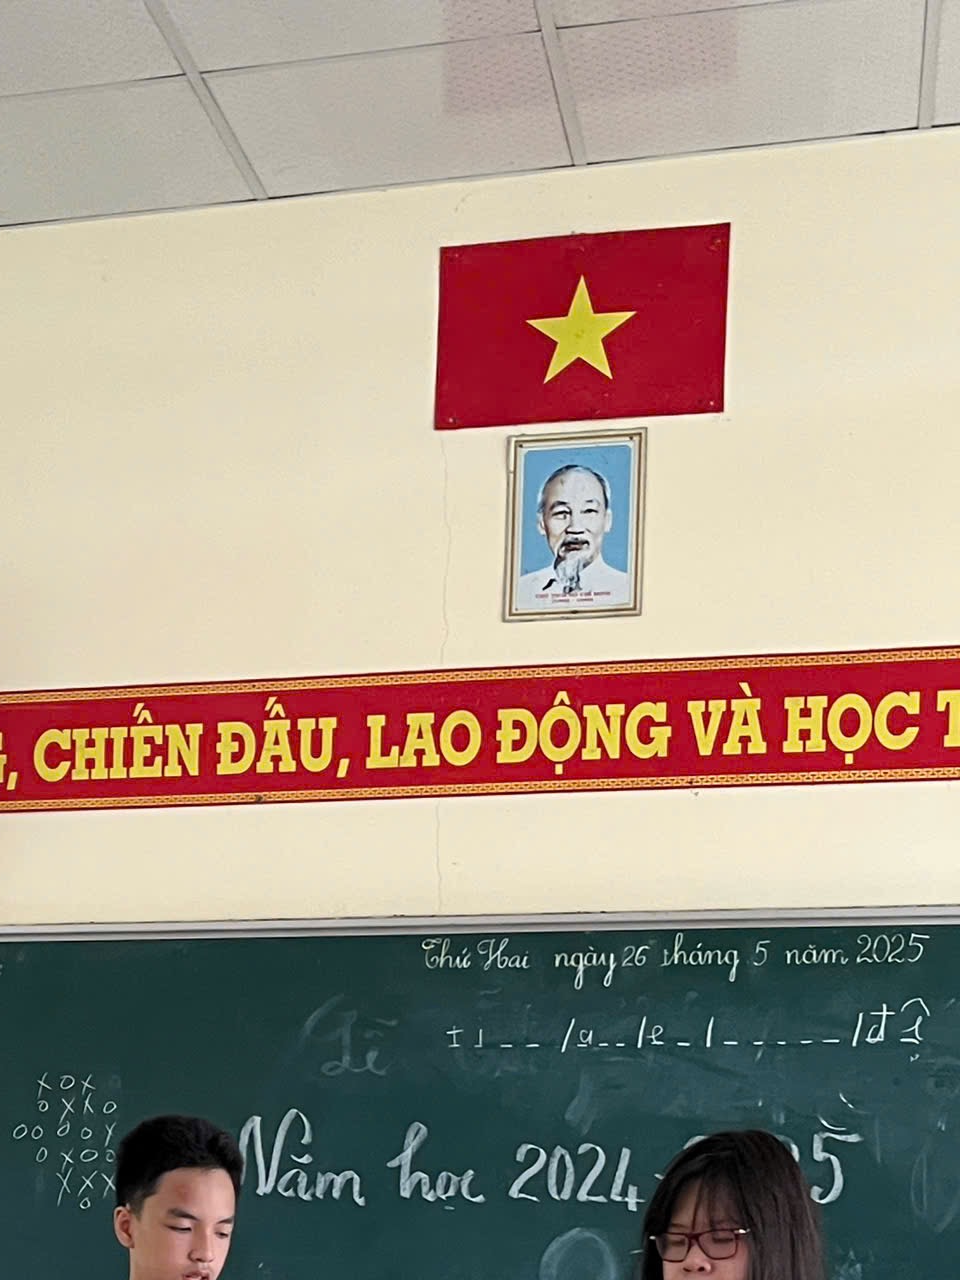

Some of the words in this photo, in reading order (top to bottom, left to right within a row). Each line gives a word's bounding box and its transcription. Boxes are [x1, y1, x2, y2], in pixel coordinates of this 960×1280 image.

[33, 703, 203, 783] CHIẾN
[216, 697, 350, 778] ĐẤU,
[366, 709, 482, 769] LAO
[496, 690, 672, 775] ĐỘNG
[687, 682, 768, 756] VÀ
[783, 691, 920, 765] HỌC
[422, 938, 471, 969] Thứ
[477, 938, 530, 970] Hai
[554, 946, 616, 990] ngày
[621, 945, 651, 967] 26
[660, 932, 740, 982] tháng
[753, 940, 771, 966] 5
[785, 944, 848, 965] năm
[856, 933, 930, 964] 2025
[239, 1108, 366, 1206] Năm
[386, 1121, 486, 1210] học
[508, 1143, 645, 1212] 2024
